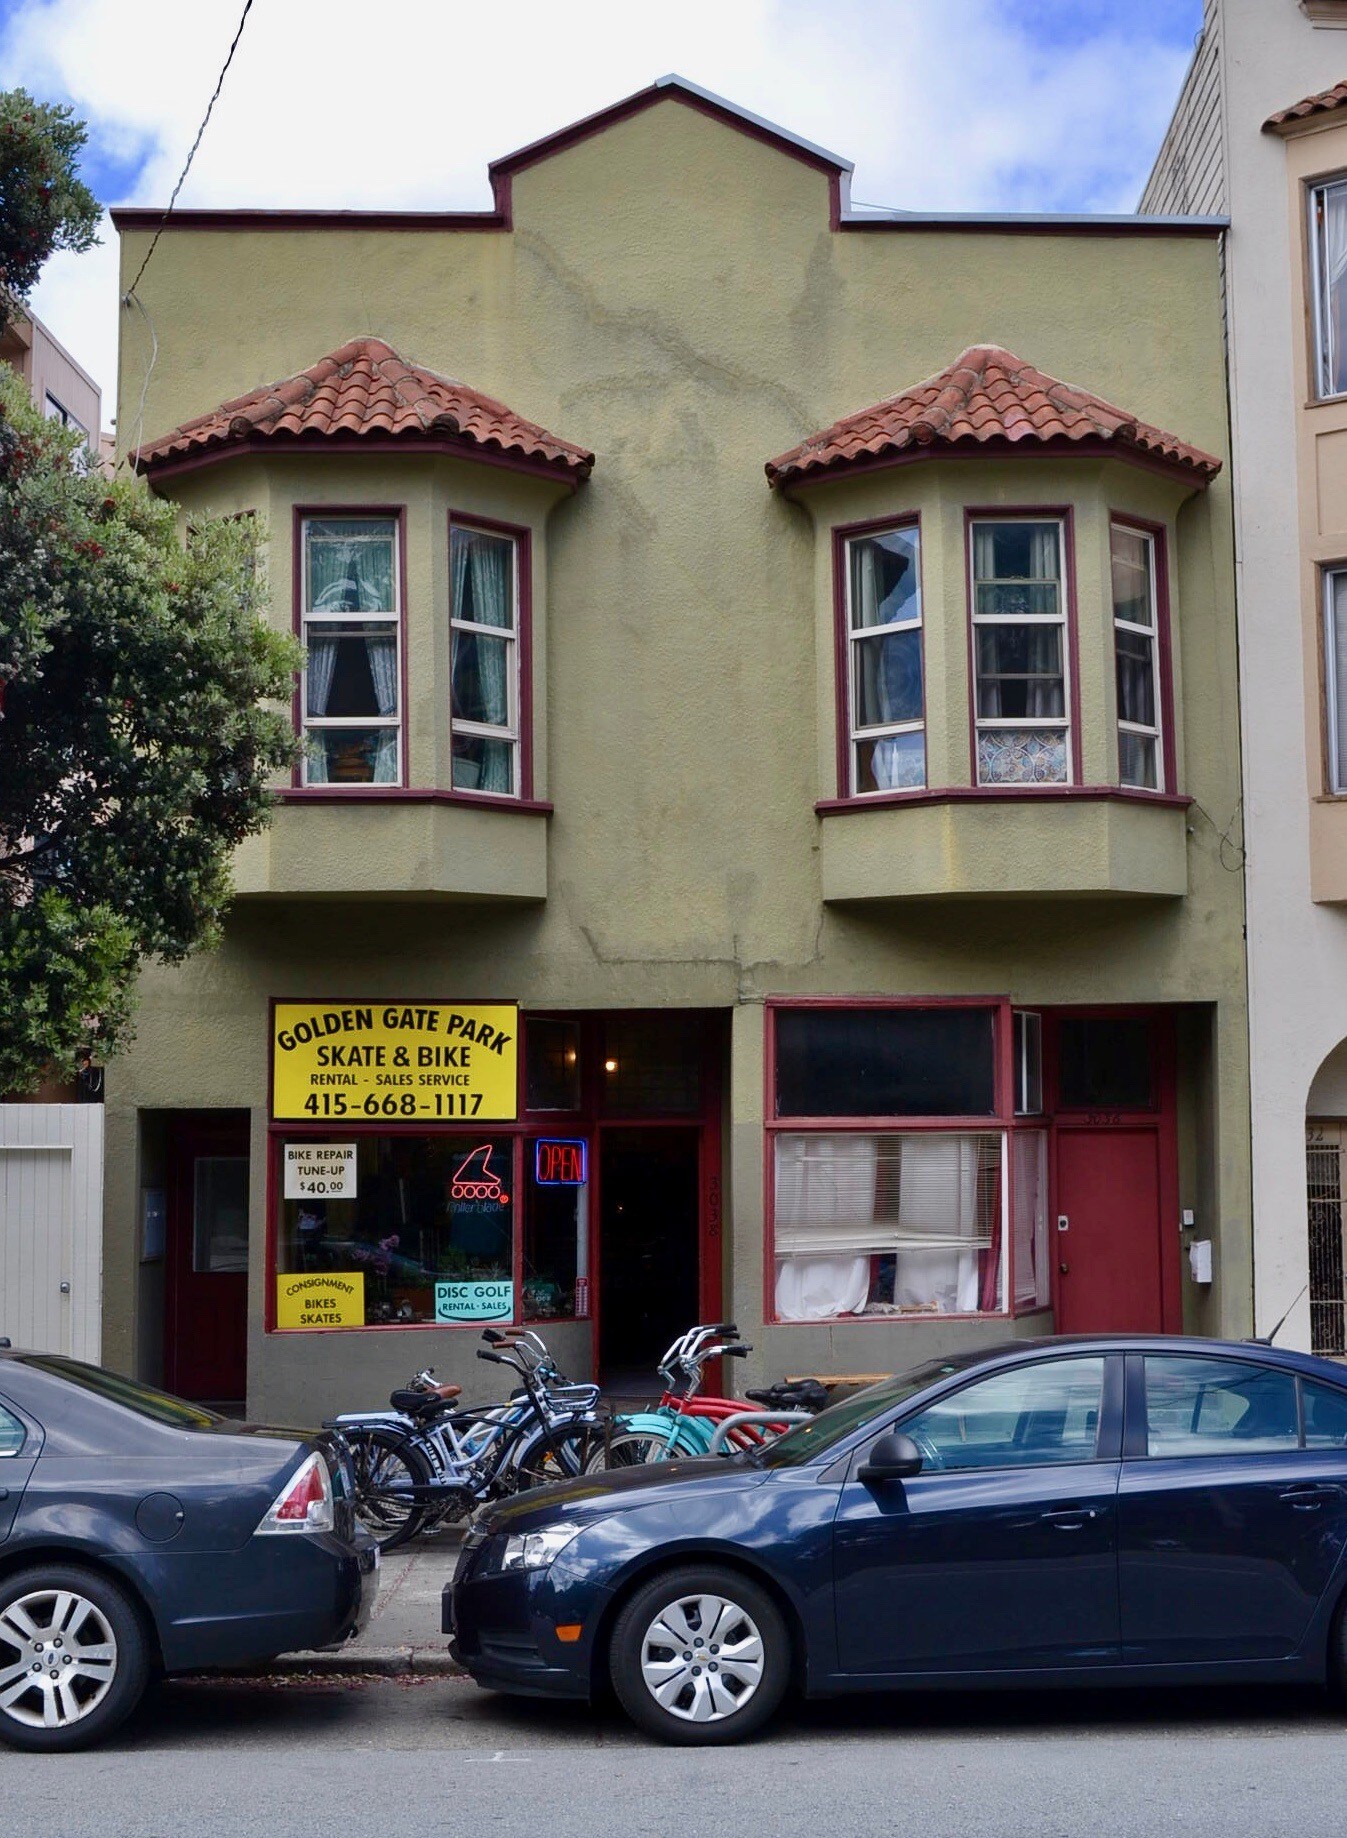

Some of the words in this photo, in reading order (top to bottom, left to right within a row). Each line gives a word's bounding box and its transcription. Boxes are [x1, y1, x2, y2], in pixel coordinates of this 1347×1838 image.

[277, 1008, 373, 1052] GOLDEN
[383, 1008, 439, 1031] GATE
[447, 1014, 512, 1055] PARK
[317, 1045, 386, 1067] SKATE
[392, 1046, 410, 1067] &
[418, 1046, 471, 1067] BIKE
[310, 1074, 358, 1086] RENTAL
[375, 1074, 413, 1086] SALES
[418, 1074, 470, 1086] SERVICE
[304, 1093, 483, 1116] 415-668-1117
[288, 1150, 312, 1160] BIKE
[316, 1150, 353, 1160] REPAIR
[538, 1145, 581, 1181] OPEN
[297, 1165, 345, 1176] TUNE-UP
[300, 1181, 343, 1194] $40.00
[286, 1278, 355, 1297] CONSIGNMENT
[437, 1286, 468, 1299] DISC
[474, 1286, 511, 1298] GOLF
[304, 1298, 336, 1309] BIKES
[442, 1303, 475, 1311] RENTAL
[482, 1301, 507, 1310] SALES
[300, 1313, 341, 1324] SKATES
